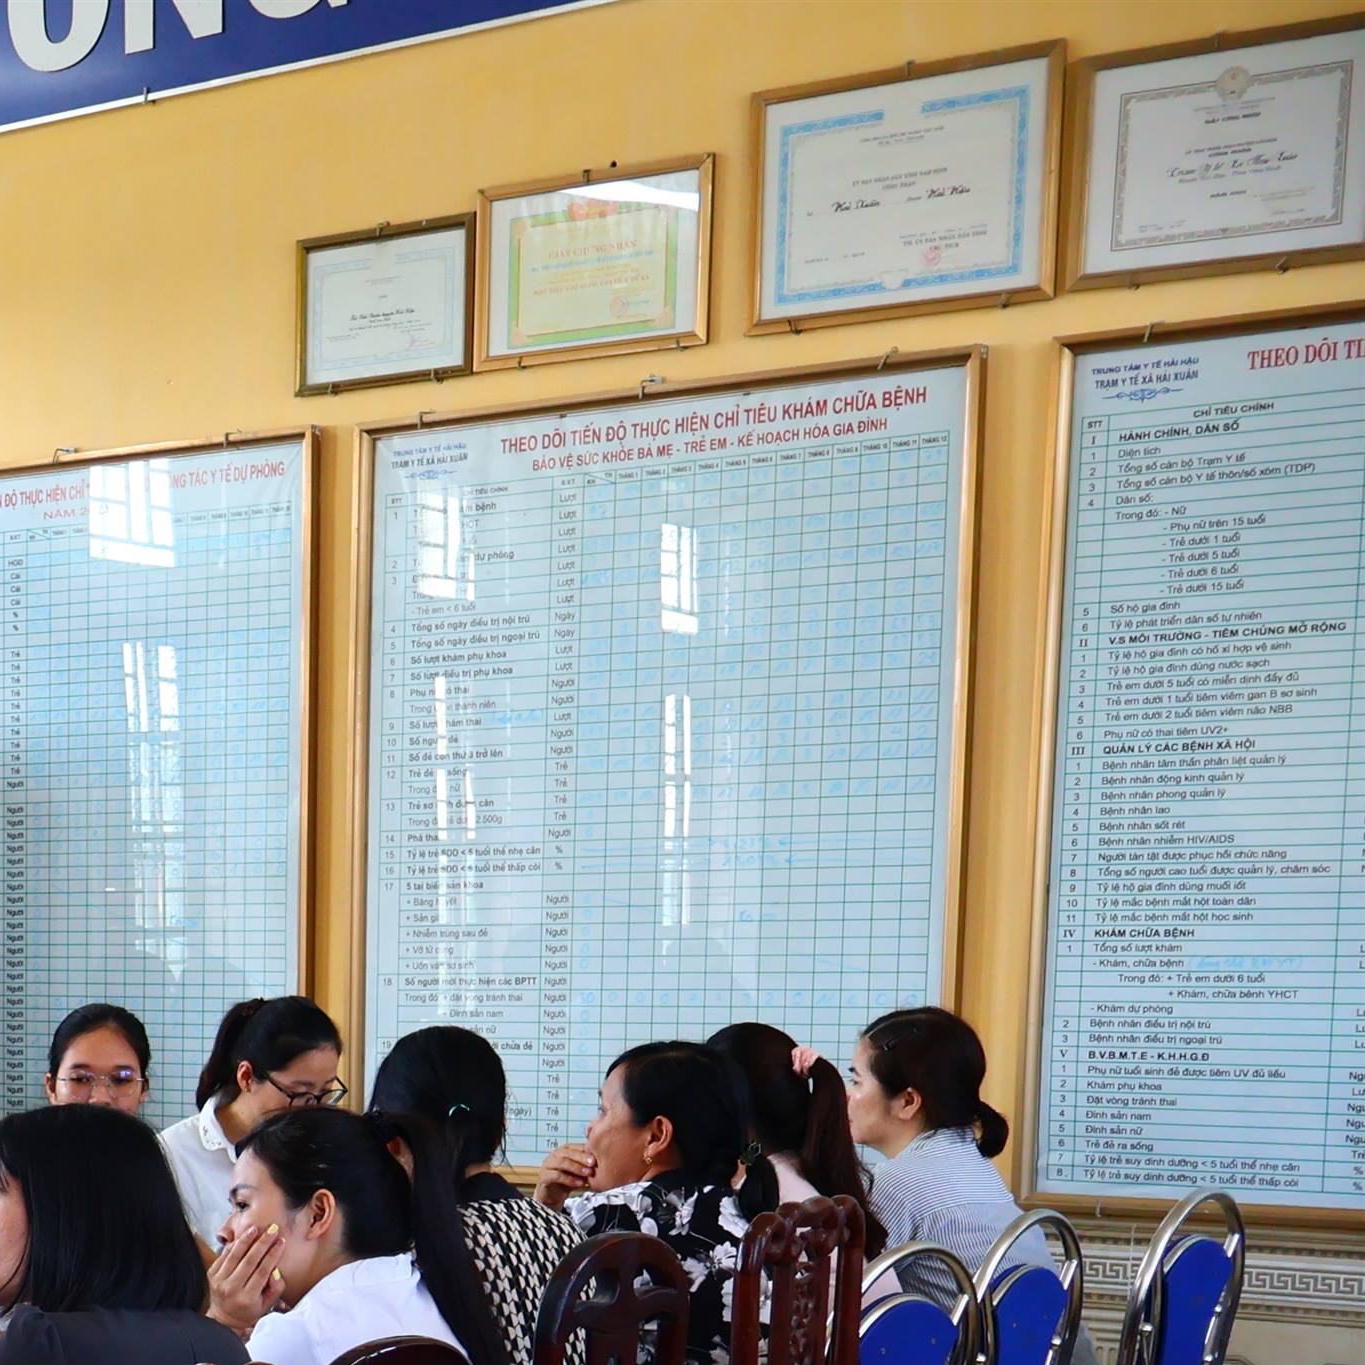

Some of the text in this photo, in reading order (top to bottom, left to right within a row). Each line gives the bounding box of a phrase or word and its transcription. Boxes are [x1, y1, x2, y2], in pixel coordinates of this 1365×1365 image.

[1248, 337, 1365, 370] THEO DÕI TI
[1193, 401, 1275, 418] CHỈ TIÊU CHÍNH
[501, 385, 927, 454] THEO DÕI TIẾN ĐỘ THỰC HIỆN CHỈ TIÊU KHÁM CHỮA BỆNH
[1087, 419, 1103, 428] STT
[1119, 429, 1151, 442] HÀNH
[1154, 425, 1192, 438] CHÍNH,
[1196, 421, 1220, 434] DÂN
[1223, 419, 1240, 431] SỐ
[533, 417, 887, 471] BẢO VỆ SỨC KHỎE BÀ MẸ TRẺ EM KẾ HOẠCH HÓA GIA ĐÌNH
[1088, 467, 1096, 476] 2
[5, 489, 17, 510] ĐỘ
[19, 487, 45, 508] THỰC
[46, 484, 66, 505] HIỆN
[69, 478, 85, 500] CHỈ
[1109, 635, 1126, 646] V.S
[1128, 632, 1150, 644] MÔI
[1153, 629, 1202, 641] TRƯỜNG
[1212, 625, 1239, 637] TIÊM
[1288, 620, 1308, 634] MỞ
[1311, 620, 1347, 633] RỘNG
[1104, 742, 1136, 755] QUẢN
[1138, 741, 1153, 753] LÝ
[1155, 740, 1179, 753] CÁC
[1182, 740, 1213, 753] BỆNH
[1216, 738, 1232, 749] XÃ
[1235, 738, 1255, 750] HỘI
[1074, 777, 1080, 786] 2
[1073, 808, 1079, 816] 4
[1072, 839, 1078, 847] 6
[1187, 833, 1235, 844] HIV/AIDS
[1094, 926, 1127, 938] KHÁM
[1130, 925, 1161, 938] CHỮA
[1164, 926, 1195, 940] BỆNH
[1267, 989, 1299, 999] YHCT
[1063, 1019, 1069, 1029] 2
[1060, 1049, 1068, 1058] V
[1060, 1080, 1066, 1089] 2
